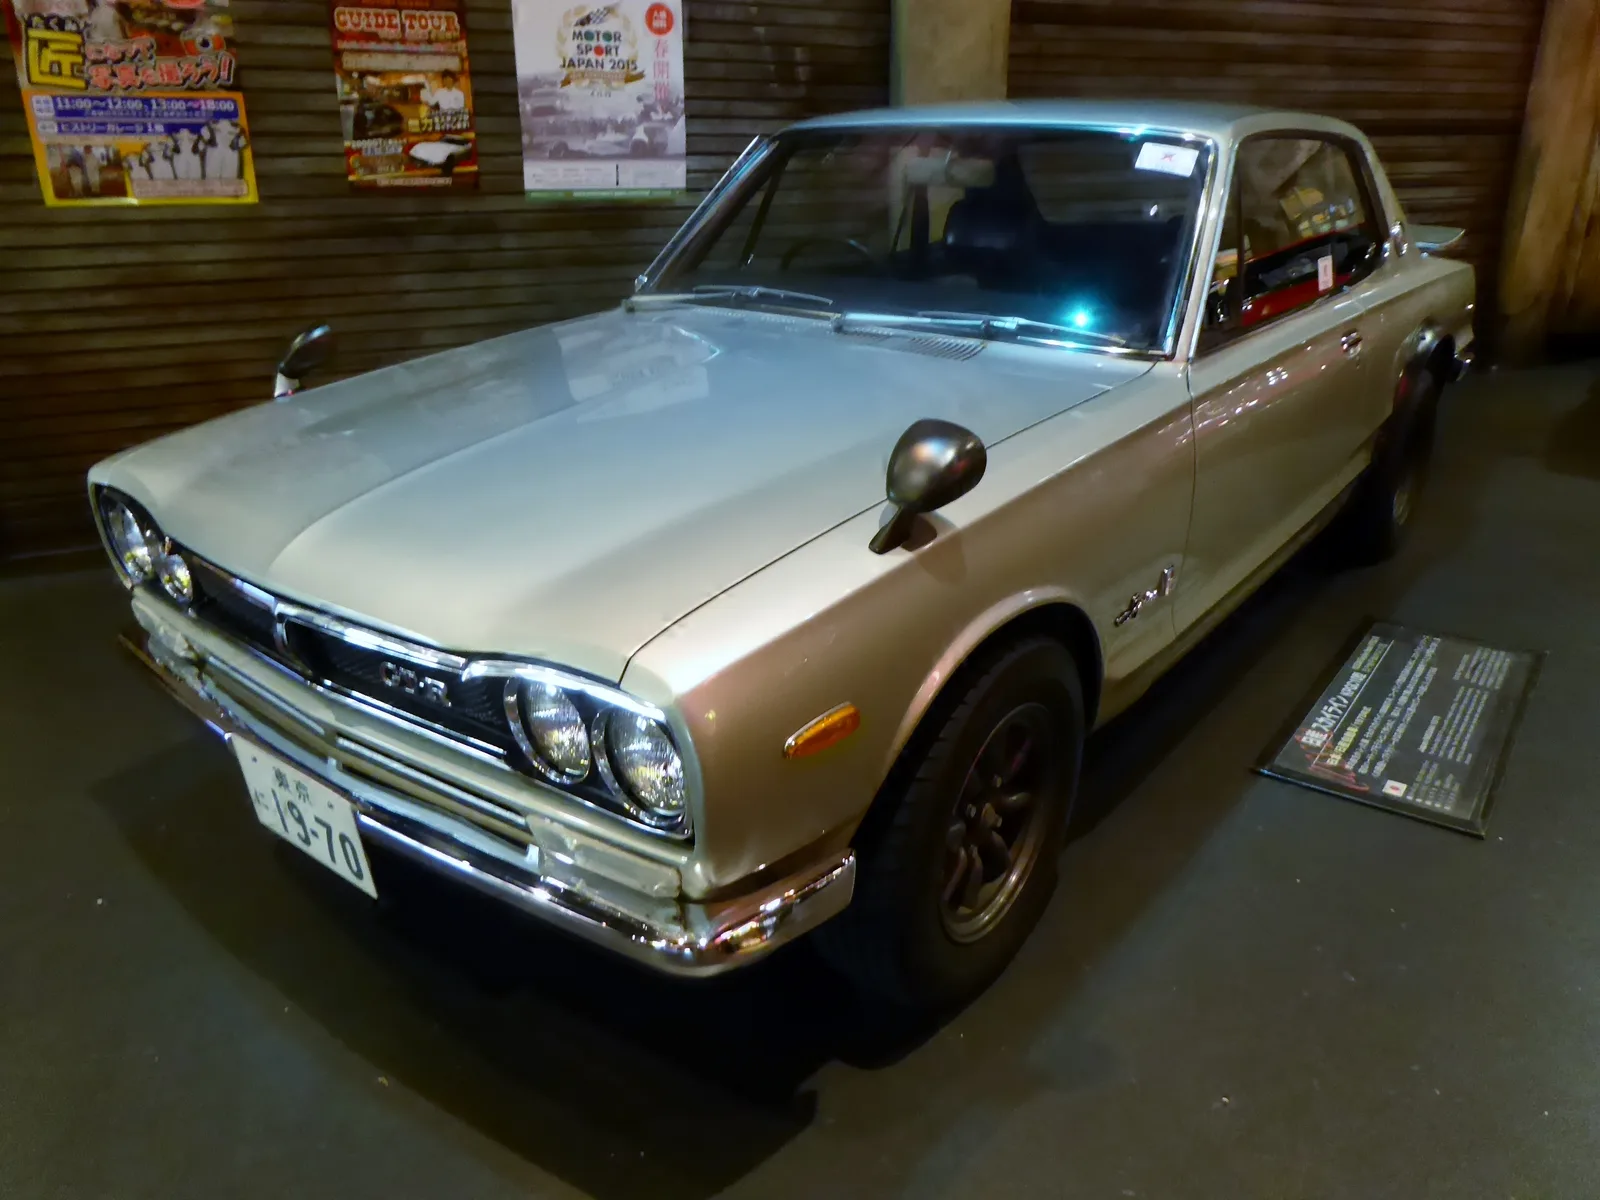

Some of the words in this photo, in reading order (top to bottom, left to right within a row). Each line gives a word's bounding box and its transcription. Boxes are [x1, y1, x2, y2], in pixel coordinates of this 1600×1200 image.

[335, 9, 400, 30] GUIDE
[402, 11, 458, 31] TOUR
[572, 30, 621, 43] MOTOR
[28, 28, 85, 89] 匠
[576, 44, 620, 57] SPORT
[560, 58, 604, 70] JAPAN
[272, 766, 312, 806] 東京
[271, 788, 364, 880] 19-70
